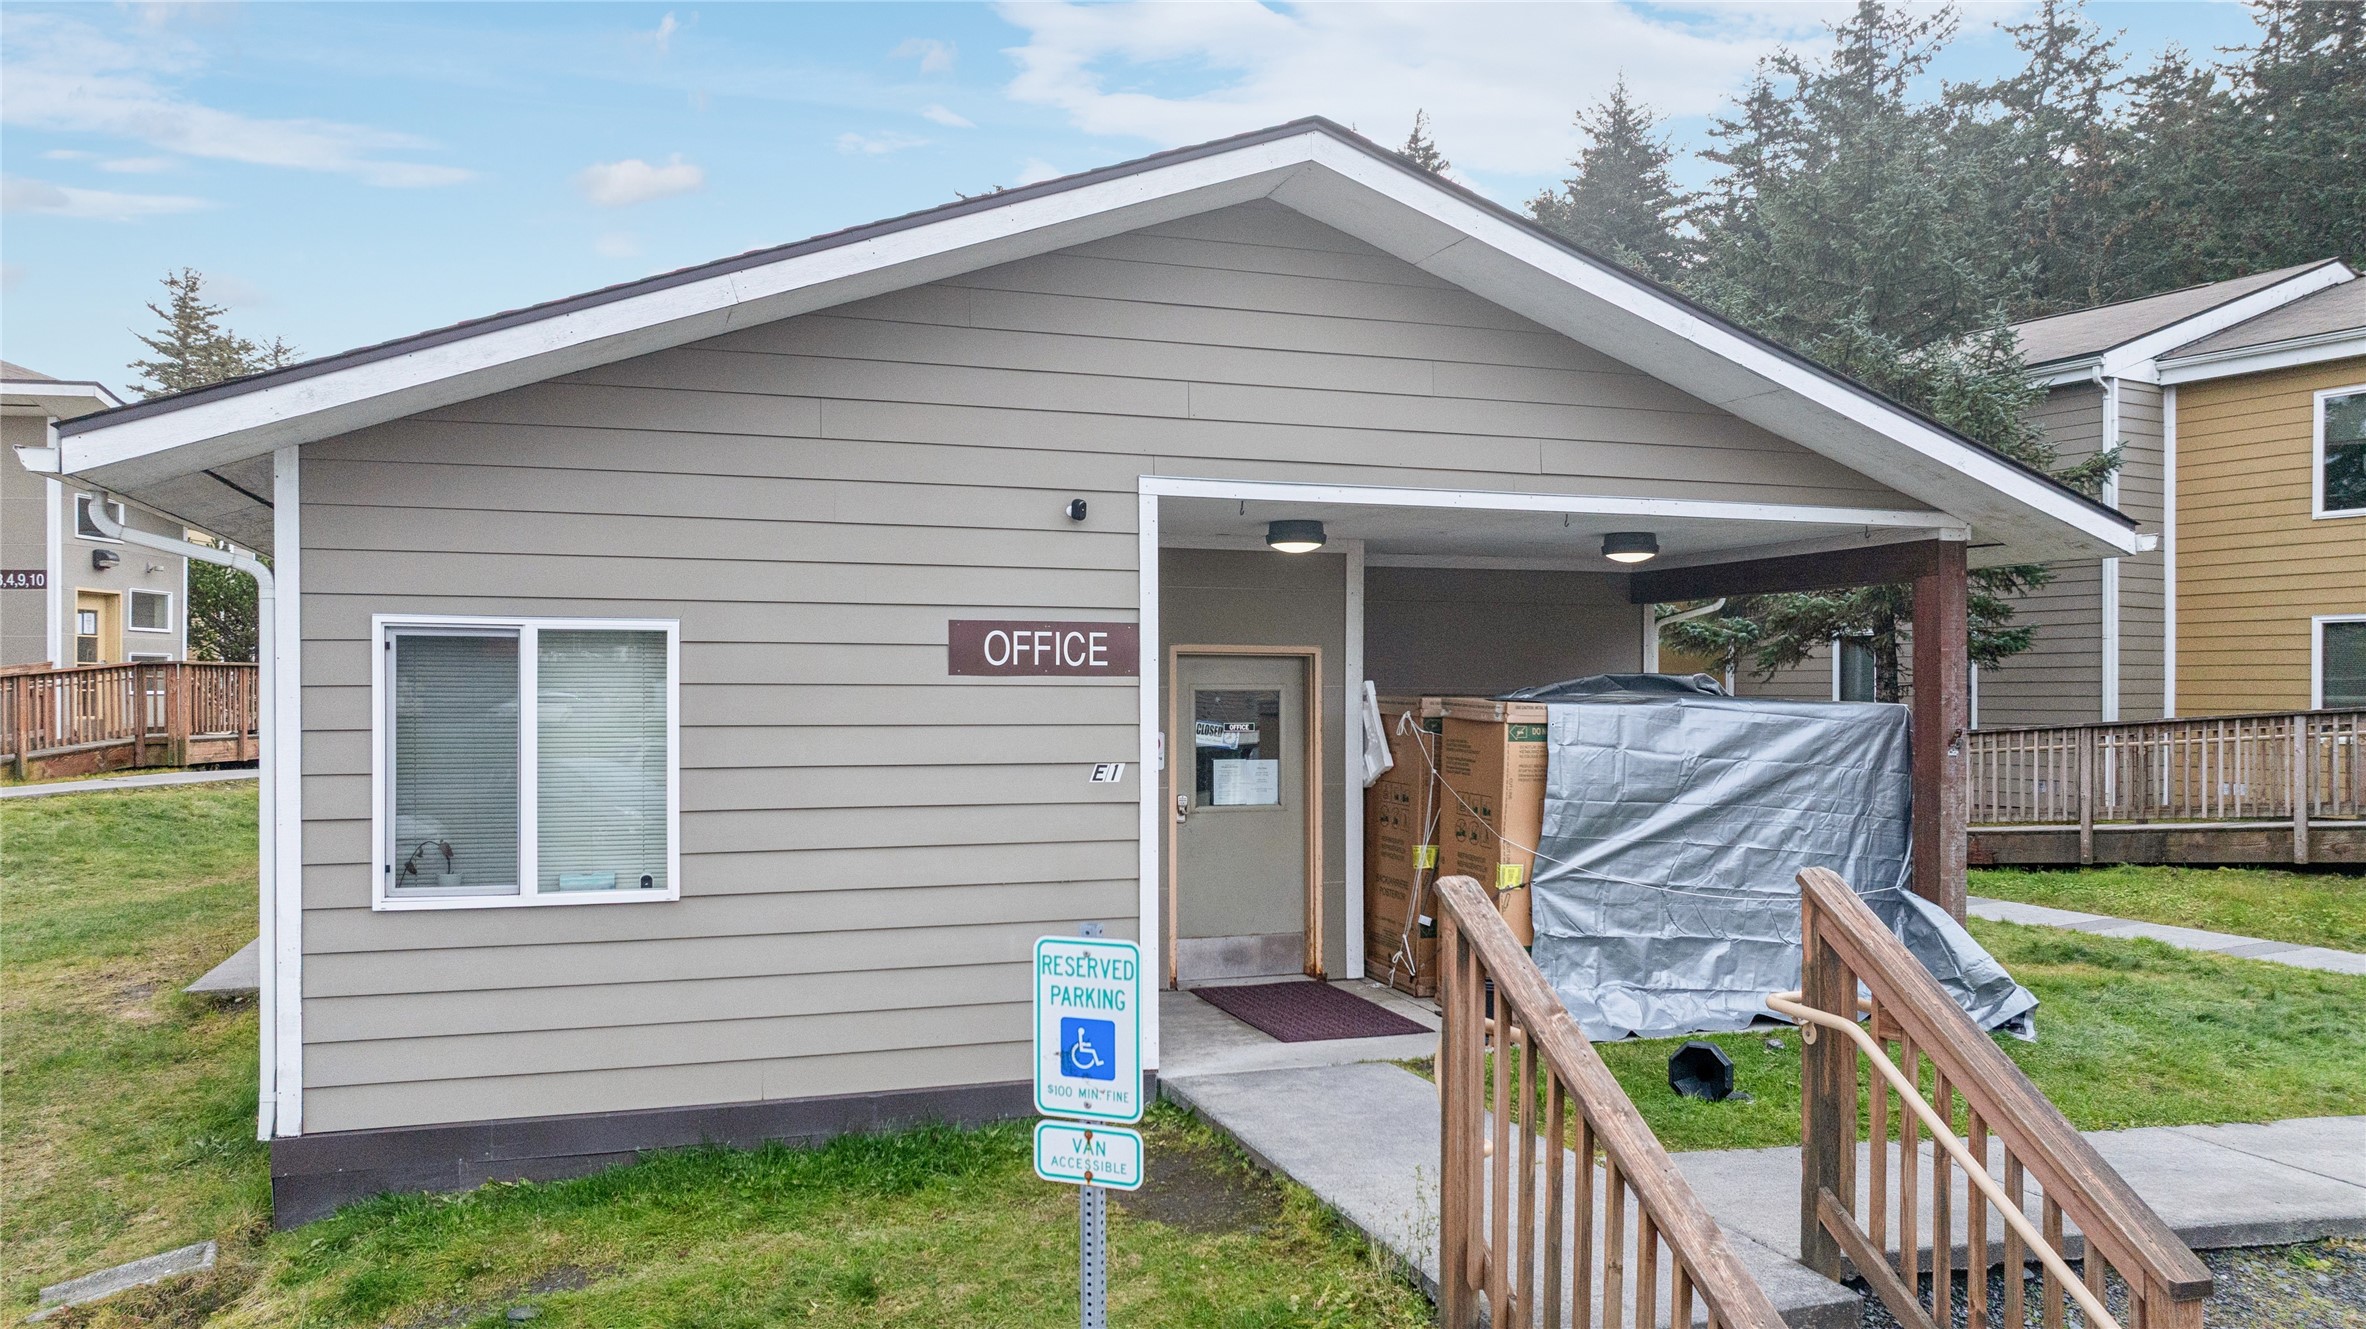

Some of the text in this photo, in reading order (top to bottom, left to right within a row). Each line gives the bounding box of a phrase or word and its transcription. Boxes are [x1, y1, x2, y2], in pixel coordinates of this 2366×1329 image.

[984, 630, 1109, 667] OFFICE
[1196, 723, 1224, 738] CLOSED
[1042, 955, 1134, 981] RESERVED
[1051, 985, 1125, 1011] PARKING
[1047, 1084, 1073, 1097] $100
[1106, 1090, 1129, 1104] FINE
[1072, 1138, 1106, 1157] VAN
[1051, 1155, 1127, 1175] ACCESSIBLE
